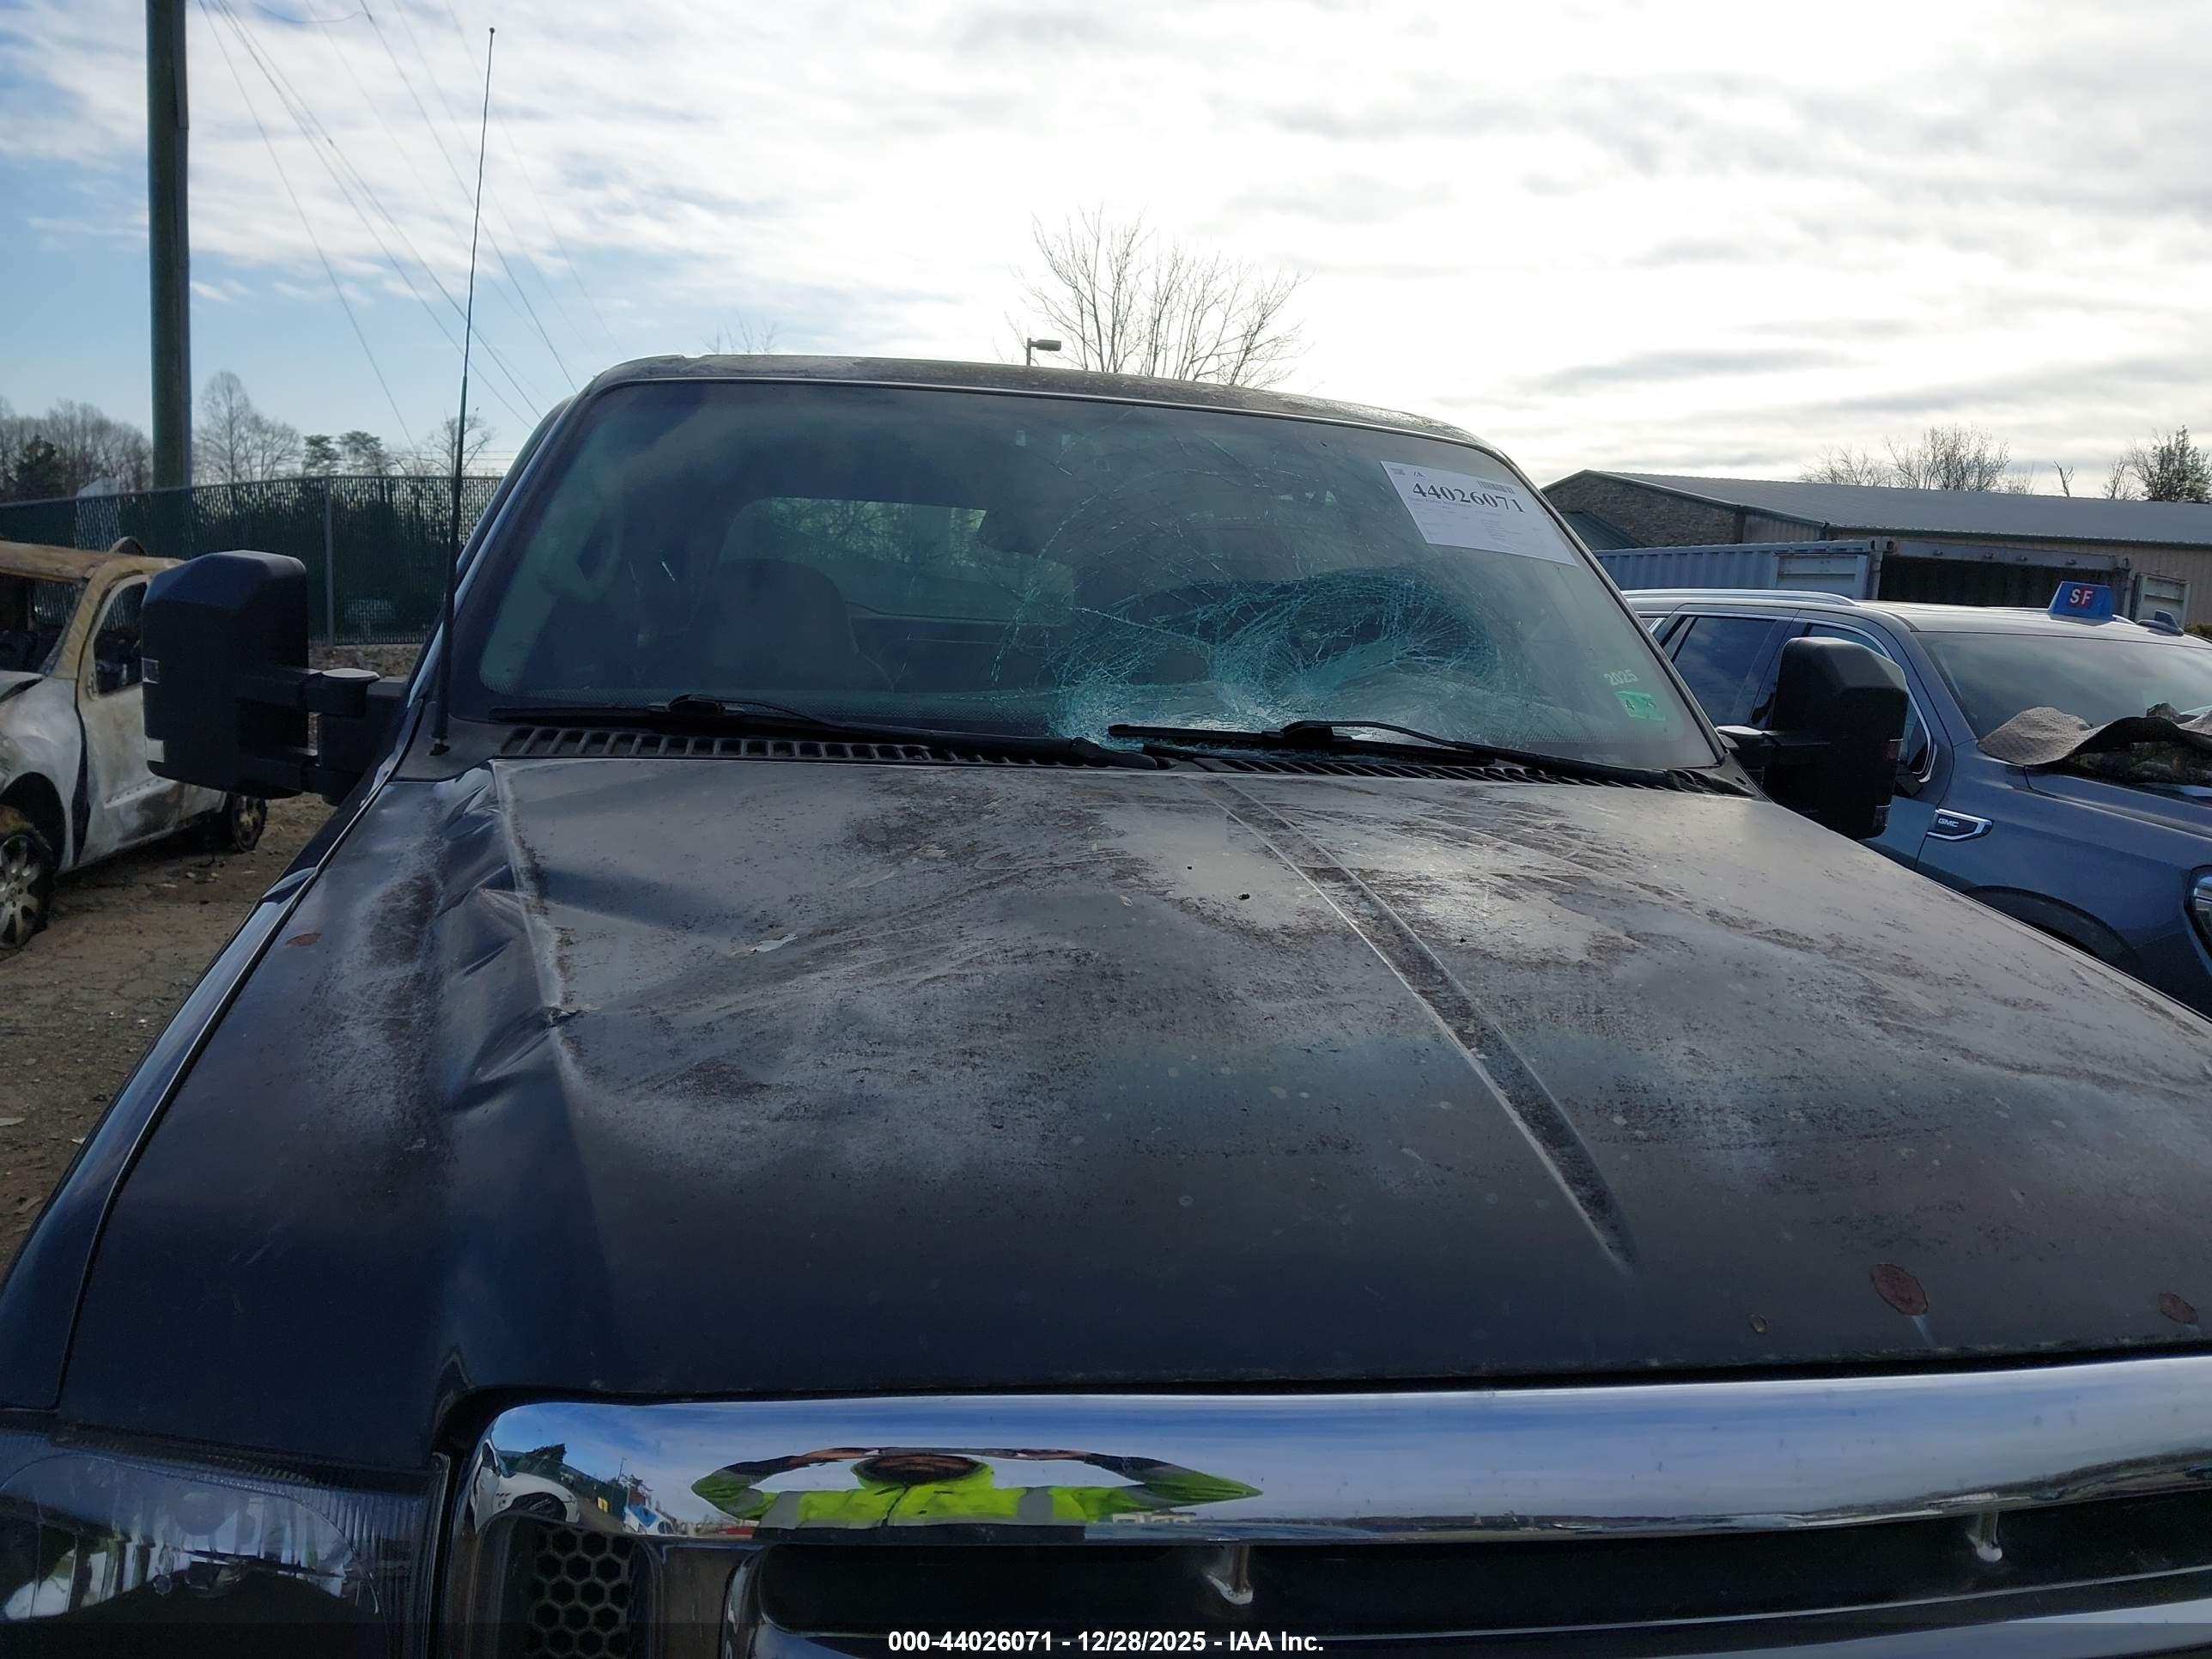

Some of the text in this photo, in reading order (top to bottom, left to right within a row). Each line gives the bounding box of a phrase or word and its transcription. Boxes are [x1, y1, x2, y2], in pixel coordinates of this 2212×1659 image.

[1413, 483, 1526, 514] 44026071
[2069, 588, 2094, 605] SF
[1938, 817, 1960, 828] GMC
